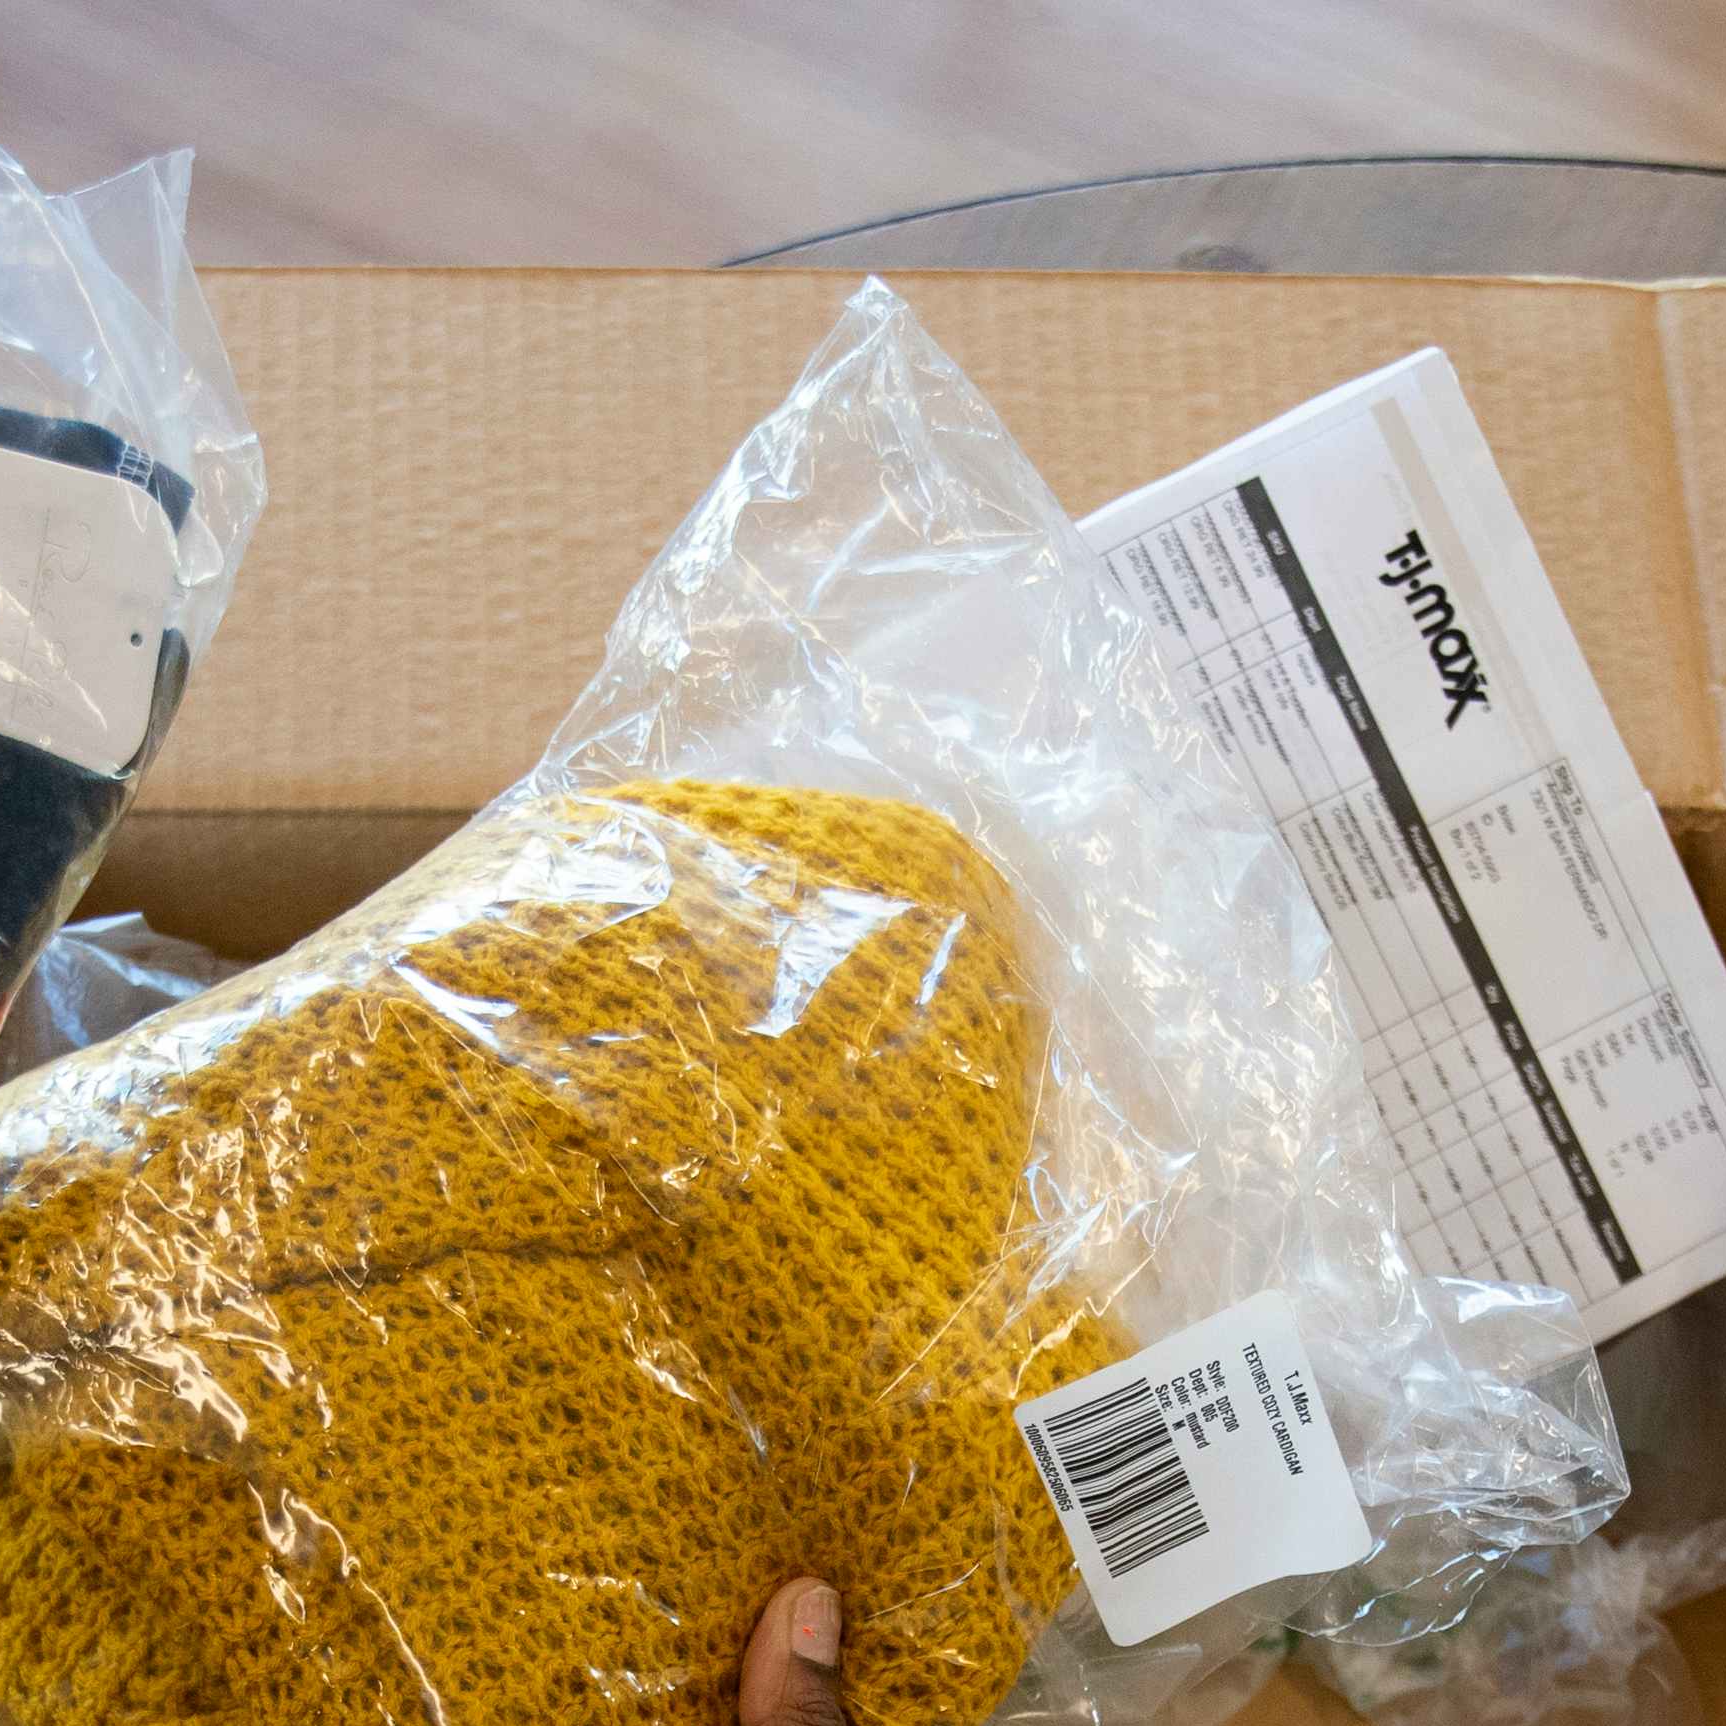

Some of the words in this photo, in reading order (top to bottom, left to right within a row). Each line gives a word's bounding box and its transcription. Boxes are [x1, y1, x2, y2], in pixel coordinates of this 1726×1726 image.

[1552, 764, 1576, 797] Ship
[1568, 797, 1586, 817] To
[1658, 991, 1684, 1028] Order
[1673, 1029, 1714, 1092] Summary
[1188, 1367, 1209, 1399] Dept:
[1200, 1403, 1219, 1423] 005
[1206, 1360, 1226, 1393] Style:
[1242, 1342, 1272, 1395] TEXTURED
[1154, 1383, 1174, 1413] Size:
[1171, 1419, 1186, 1432] M
[1170, 1376, 1192, 1409] Color:
[1185, 1411, 1211, 1450] mustard
[1212, 1395, 1240, 1433] DDF200
[1261, 1393, 1282, 1421] COZY
[1283, 1369, 1312, 1426] T.J.Maxx
[1024, 1423, 1074, 1512] 1000609582506065
[1271, 1420, 1304, 1476] CARDIGAN
